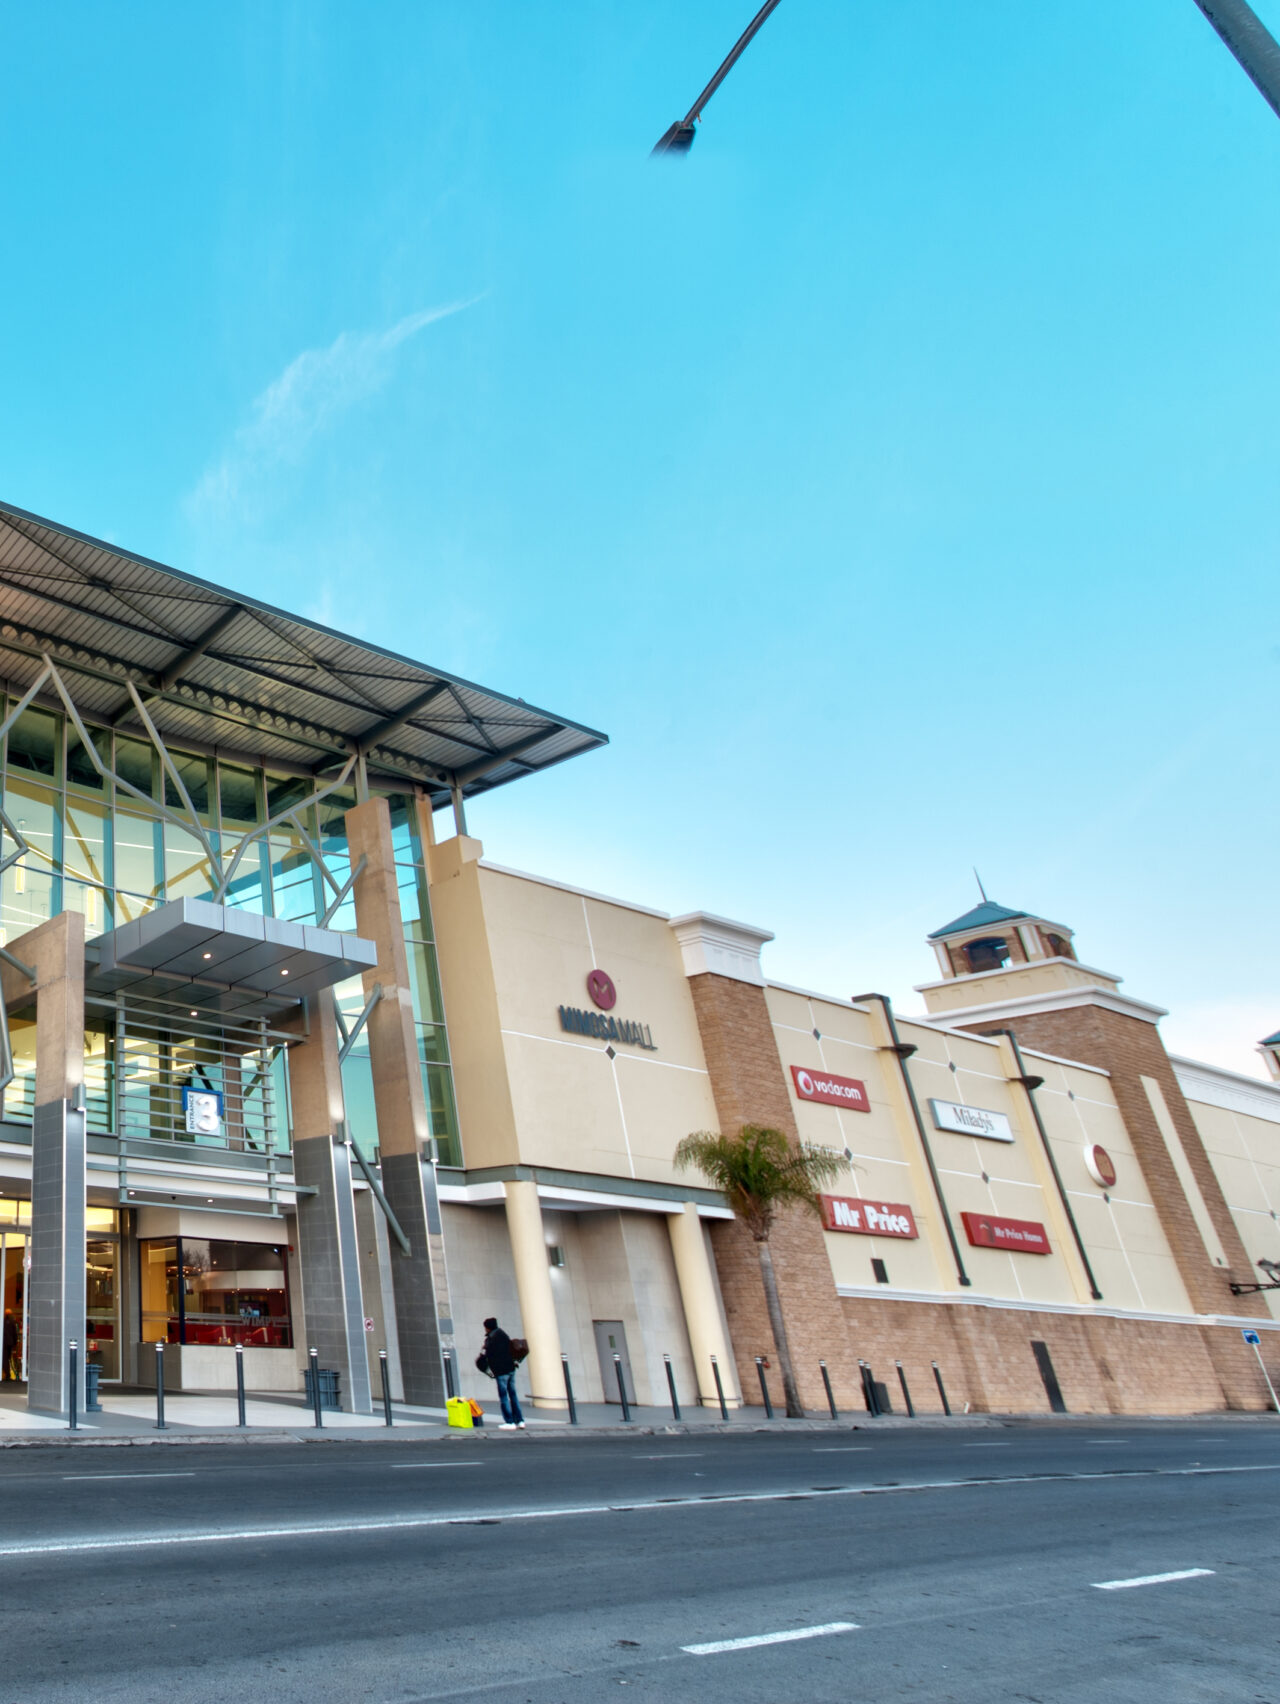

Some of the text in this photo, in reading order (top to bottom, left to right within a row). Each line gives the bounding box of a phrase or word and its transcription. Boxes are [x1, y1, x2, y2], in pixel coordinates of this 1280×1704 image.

[558, 1004, 620, 1042] MIMOSA
[813, 1079, 862, 1101] vodacom
[196, 1096, 219, 1131] 3
[832, 1201, 910, 1234] Mr Price
[994, 1226, 1005, 1238] Mr
[1005, 1228, 1023, 1241] Price
